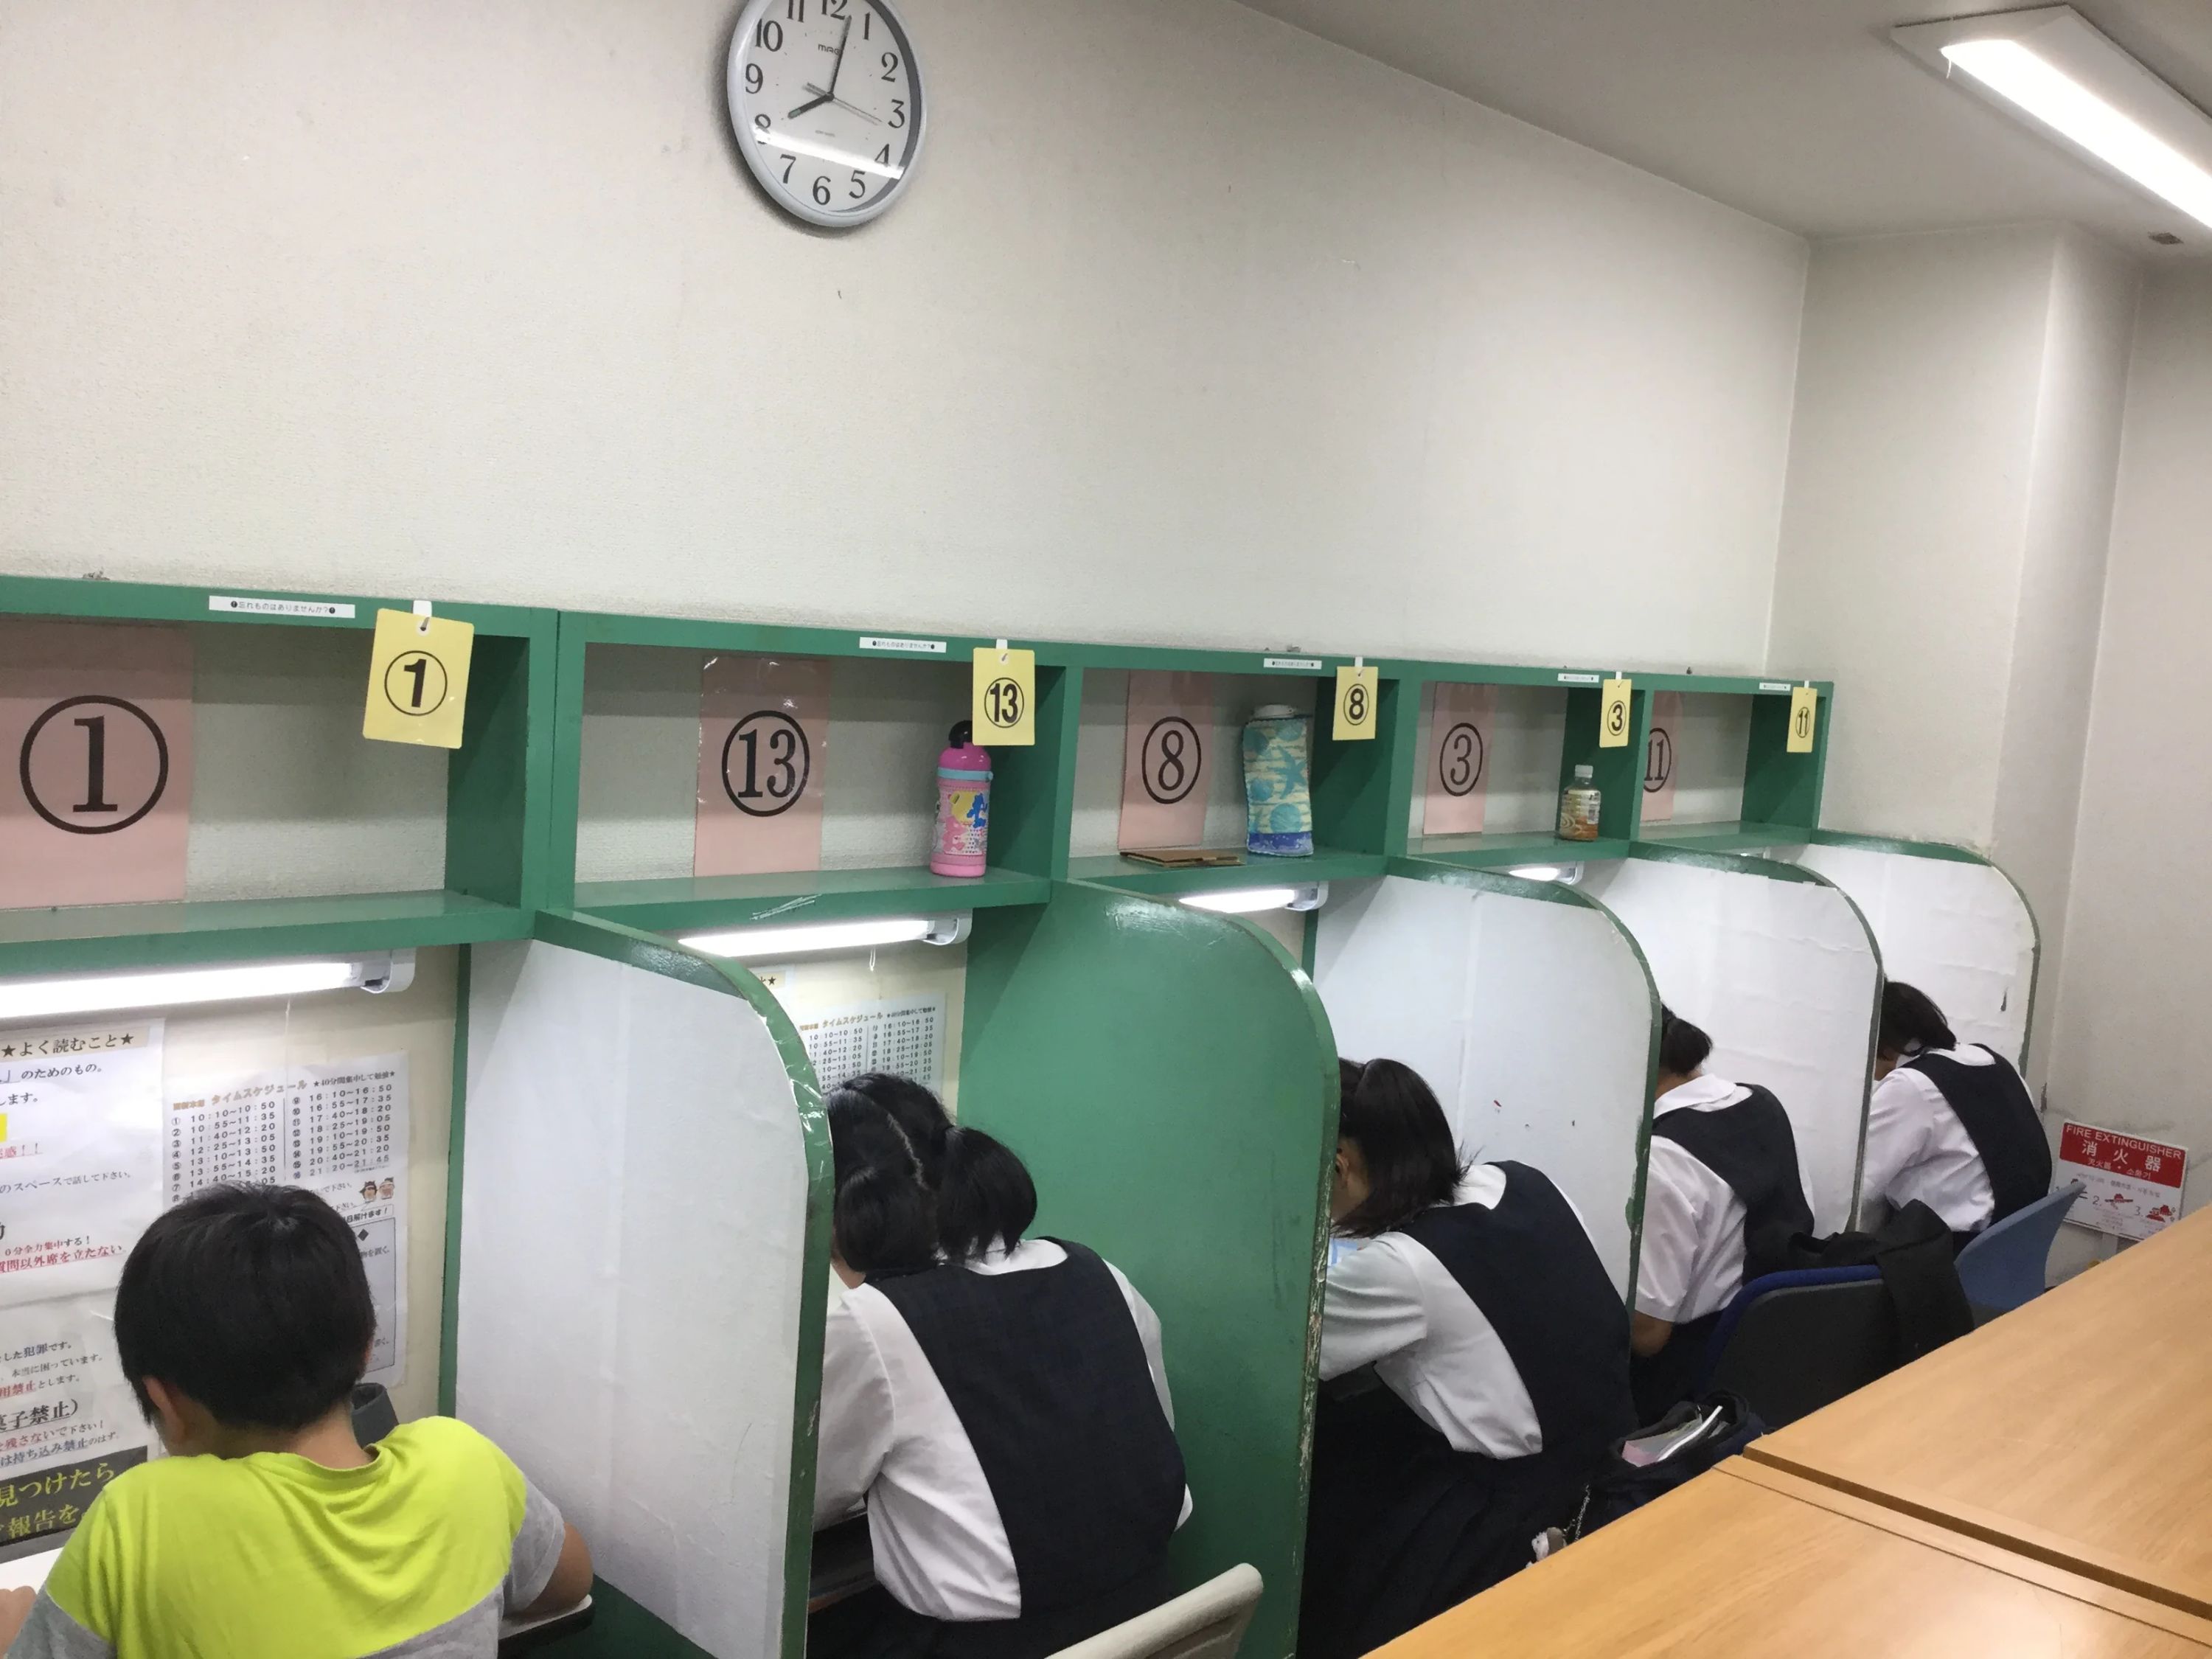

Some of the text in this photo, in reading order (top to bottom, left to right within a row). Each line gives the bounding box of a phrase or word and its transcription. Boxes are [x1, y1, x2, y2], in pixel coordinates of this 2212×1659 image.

[755, 18, 784, 52] 10
[863, 12, 870, 41] 1
[745, 63, 763, 94] 9
[880, 52, 898, 83] 2
[887, 99, 905, 128] 3
[779, 154, 796, 184] 7
[874, 144, 890, 168] 4
[813, 175, 831, 205] 6
[849, 170, 866, 199] 5
[2066, 1124, 2182, 1160] FIRE EXTINGUISHER
